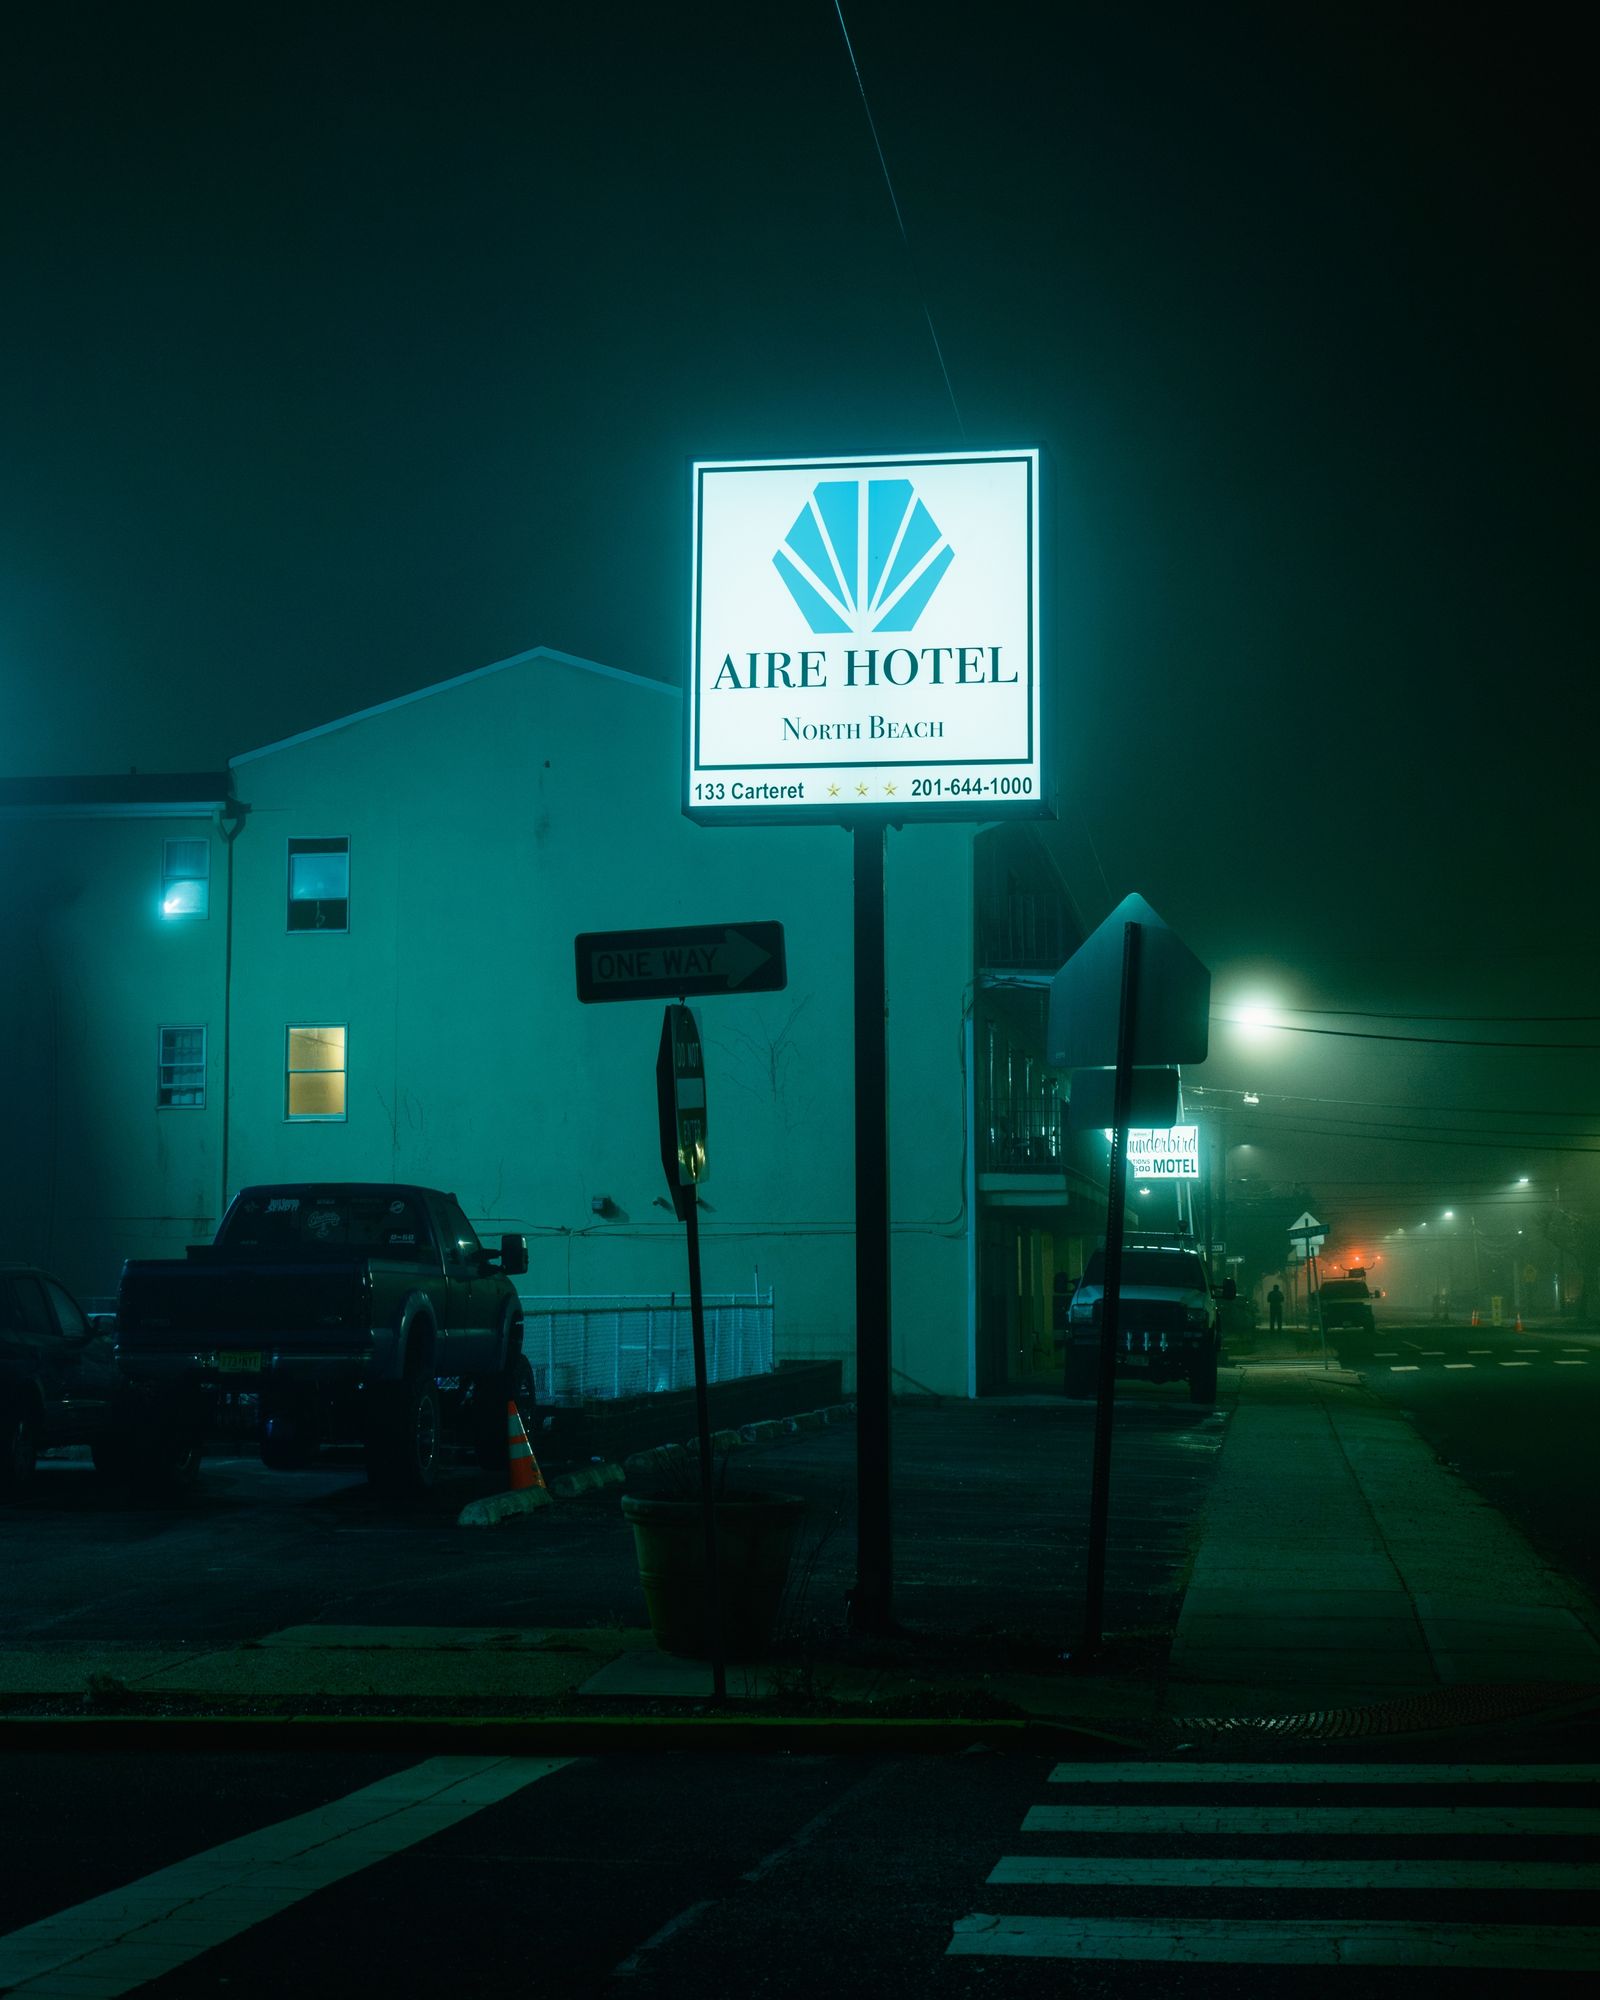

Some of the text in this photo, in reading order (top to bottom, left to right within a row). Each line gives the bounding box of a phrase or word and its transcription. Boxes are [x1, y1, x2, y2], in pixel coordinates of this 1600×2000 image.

[710, 646, 1019, 690] AIRE HOTEL
[781, 715, 945, 741] NORTH BEACH
[695, 776, 1033, 800] 133 Carteret 201-644-1000
[599, 946, 720, 979] ONE WAY
[676, 1042, 699, 1068] DO NOT
[1129, 1129, 1196, 1153] underbird
[1153, 1159, 1196, 1173] MOTEL
